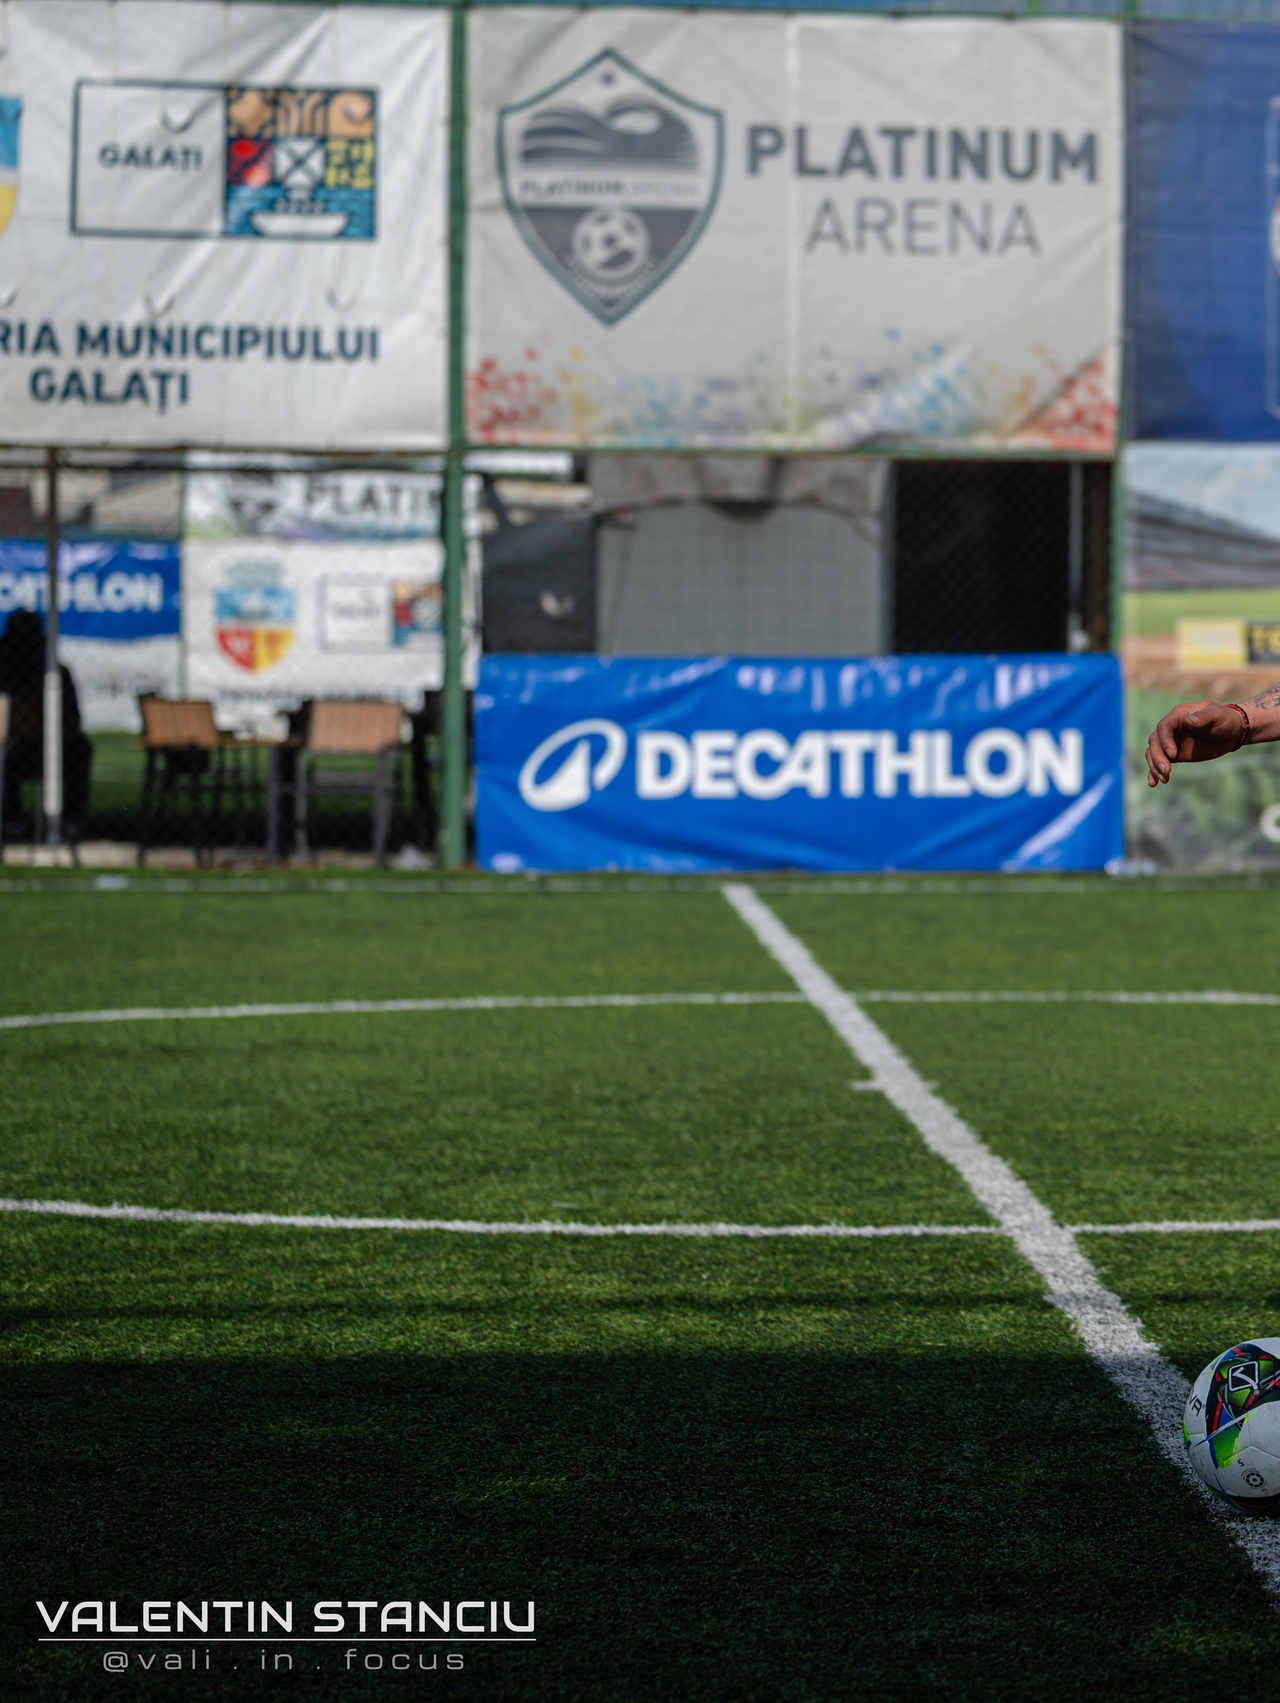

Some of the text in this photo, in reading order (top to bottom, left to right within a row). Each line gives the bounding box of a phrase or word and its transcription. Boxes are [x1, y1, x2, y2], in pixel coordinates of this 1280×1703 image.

[747, 125, 1097, 183] PLATINUM
[804, 199, 1043, 256] ARENA
[76, 321, 381, 363] MUNICIPIULUI
[29, 366, 190, 418] GALAȚI
[635, 728, 1084, 800] DECATHLON
